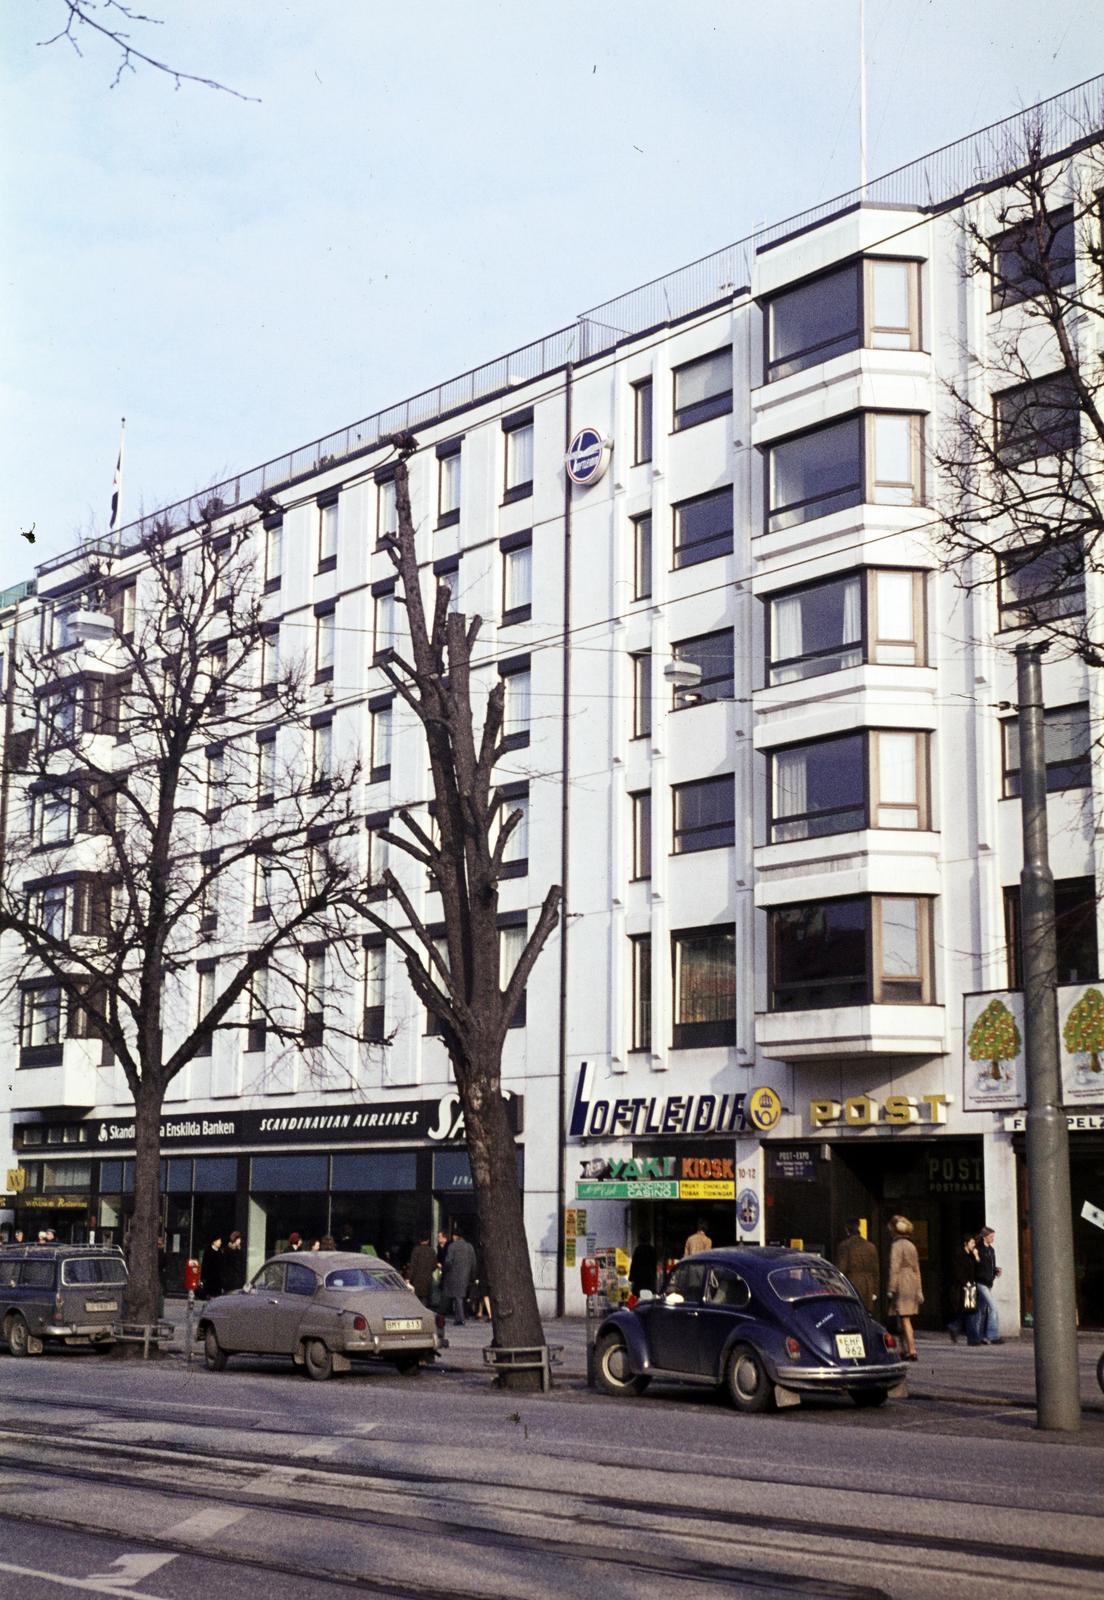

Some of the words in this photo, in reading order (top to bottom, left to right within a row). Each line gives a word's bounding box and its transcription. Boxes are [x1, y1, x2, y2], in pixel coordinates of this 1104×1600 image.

[569, 1062, 748, 1136] LOFTLEIDIR
[259, 1114, 351, 1132] SCANDINAVIAN
[353, 1110, 420, 1127] AIRLINES
[810, 1094, 951, 1127] POST
[166, 1120, 200, 1137] Enskilda
[202, 1119, 235, 1135] Banken
[682, 1157, 735, 1179] KIOSK
[928, 1157, 985, 1181] POST
[626, 1189, 672, 1198] CASINO
